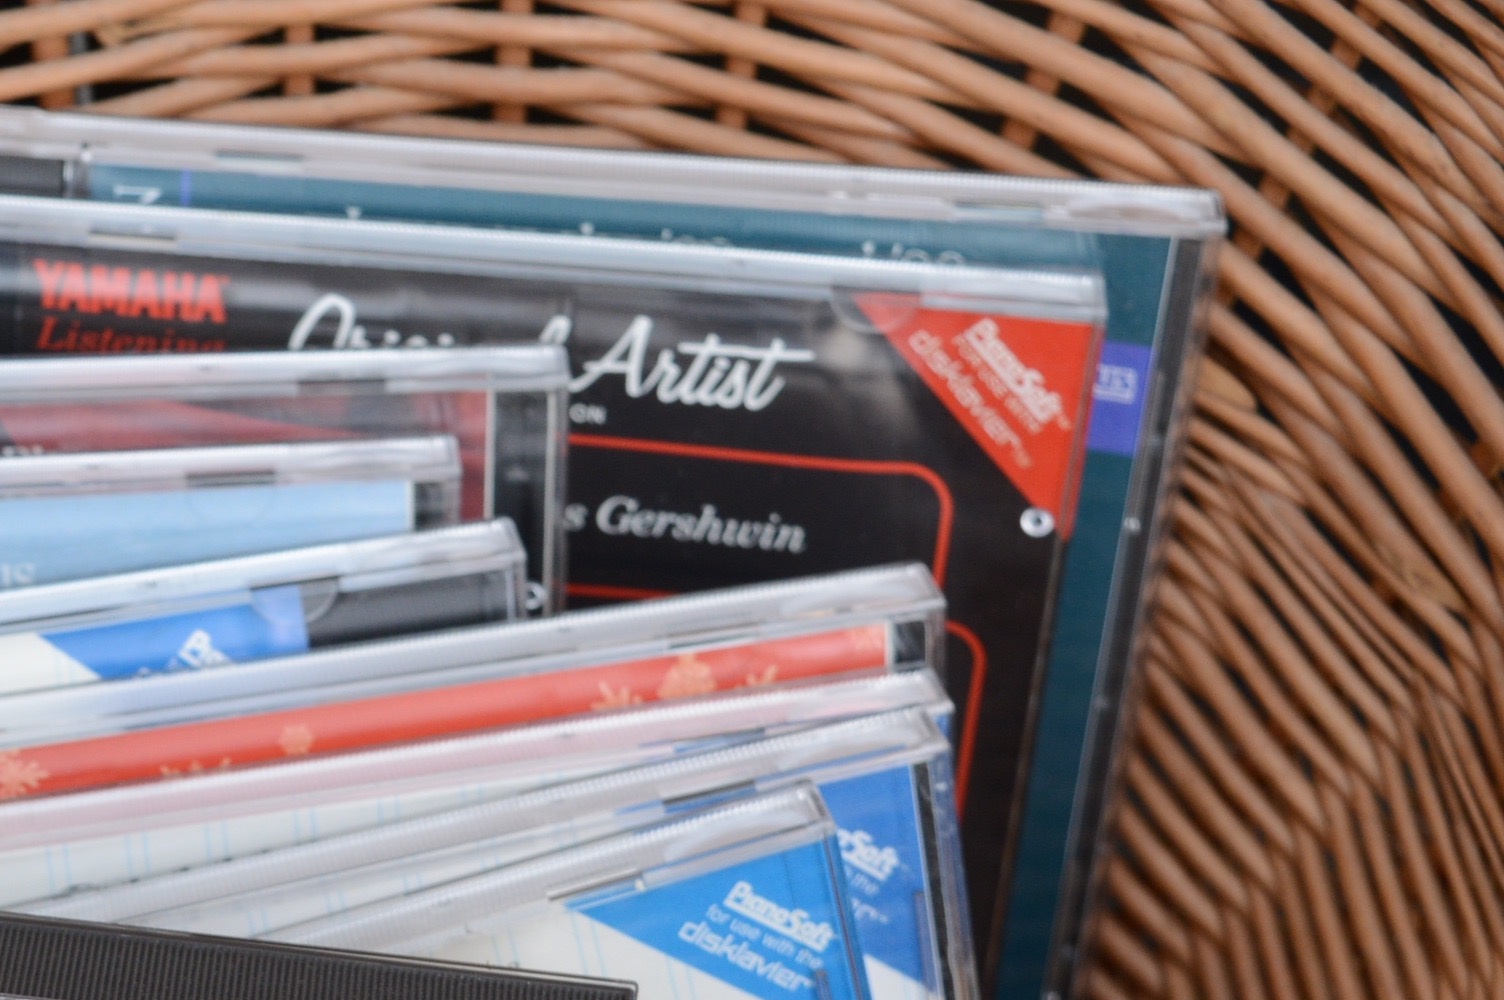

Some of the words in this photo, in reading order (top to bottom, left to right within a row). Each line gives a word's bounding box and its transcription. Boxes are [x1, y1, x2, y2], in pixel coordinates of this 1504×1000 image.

[567, 314, 816, 412] Artist
[596, 495, 807, 554] Gershwin
[705, 903, 731, 924] for
[729, 917, 762, 941] use
[762, 931, 795, 956] with
[795, 946, 824, 969] the
